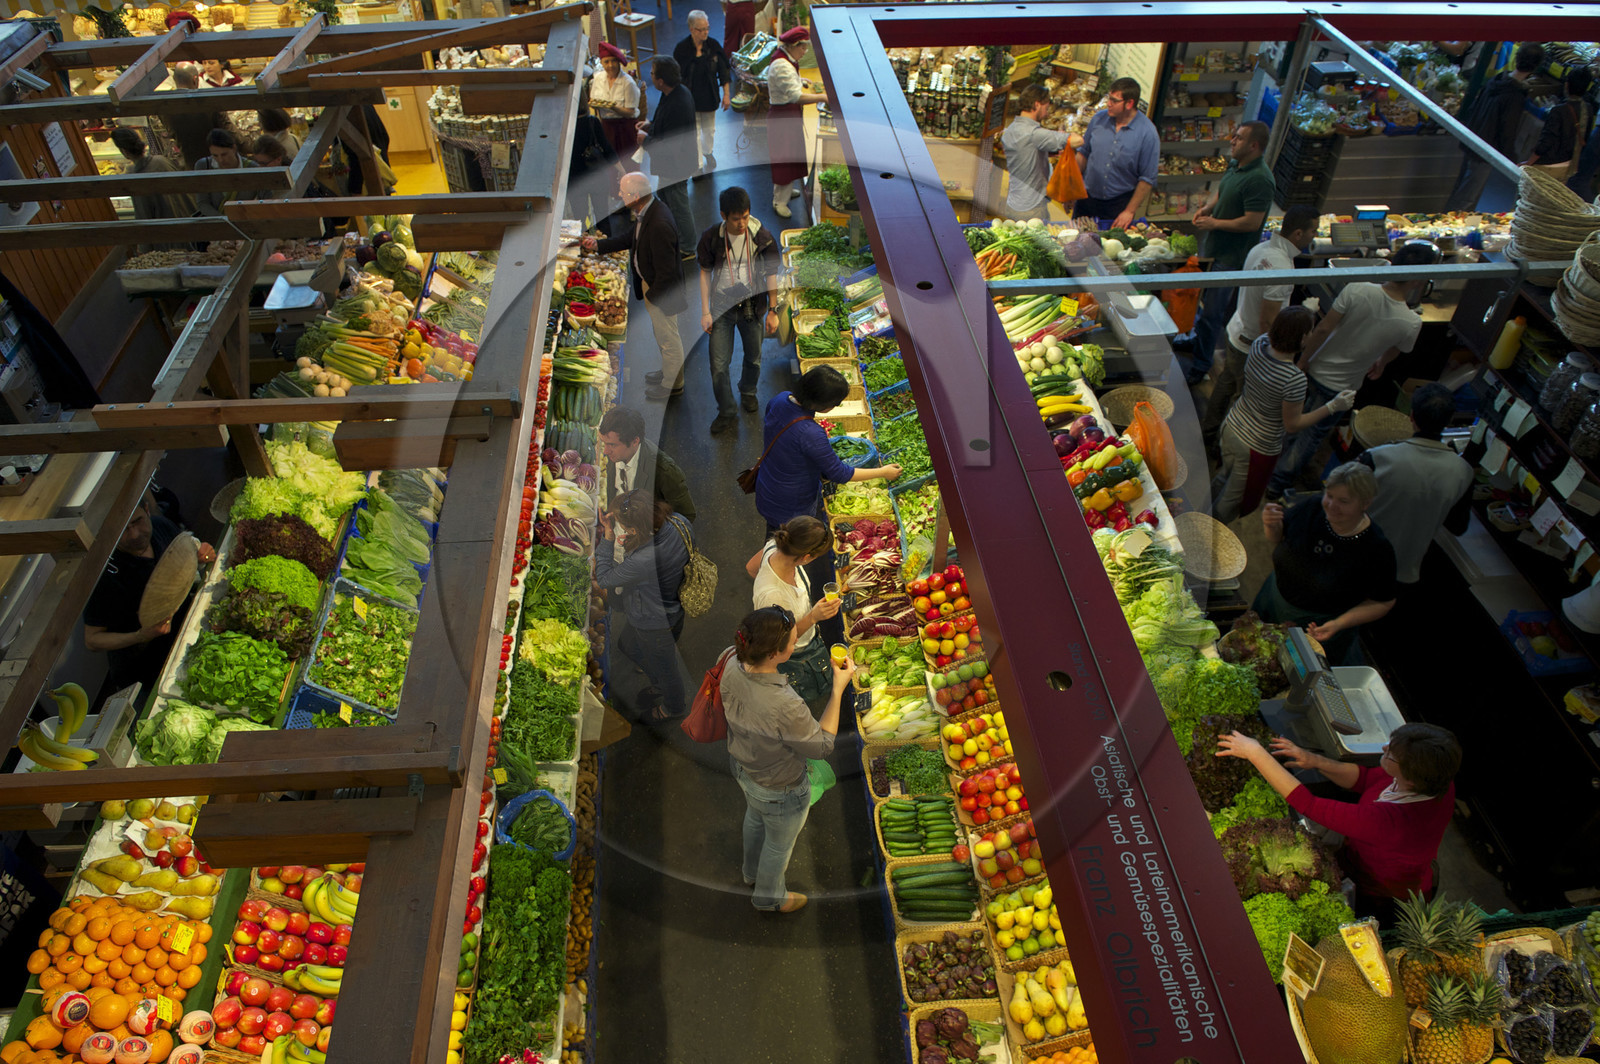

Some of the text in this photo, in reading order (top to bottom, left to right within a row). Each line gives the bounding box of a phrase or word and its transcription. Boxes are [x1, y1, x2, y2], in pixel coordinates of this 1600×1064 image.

[1078, 845, 1160, 1048] Franz Olbrich
[1091, 765, 1194, 1043] Obst- und Gemüsespezialitäten
[1100, 735, 1218, 1040] Asiatische und Lateinamerikanische
